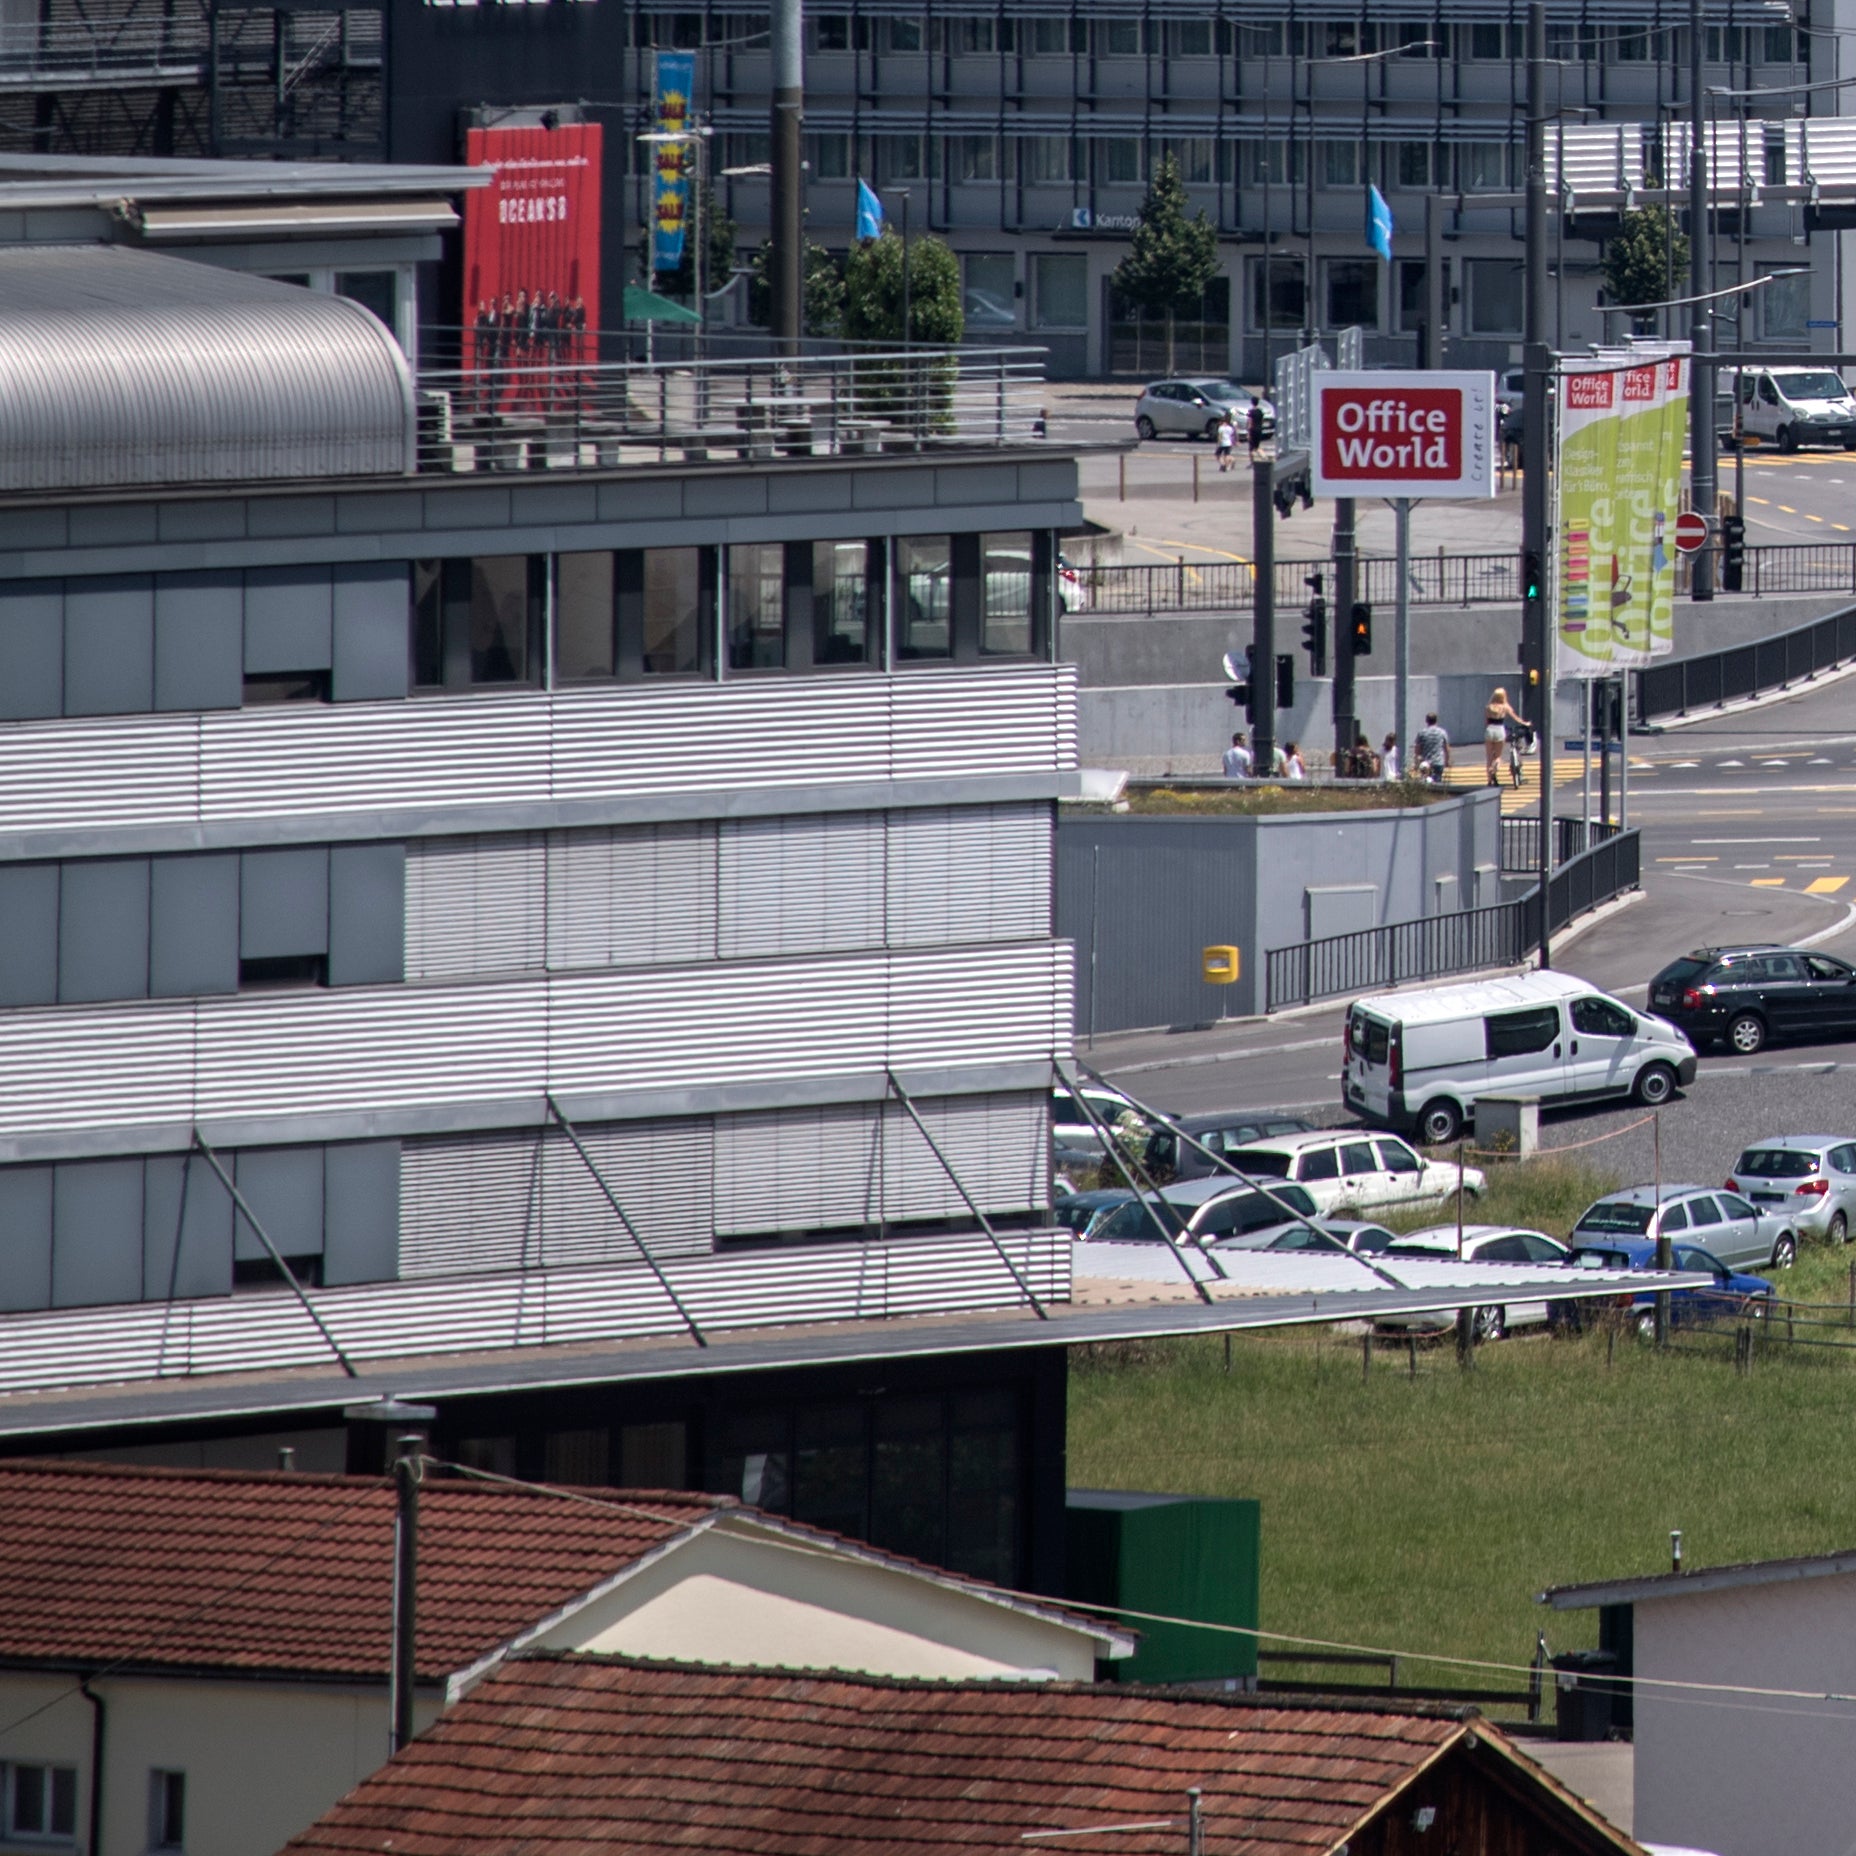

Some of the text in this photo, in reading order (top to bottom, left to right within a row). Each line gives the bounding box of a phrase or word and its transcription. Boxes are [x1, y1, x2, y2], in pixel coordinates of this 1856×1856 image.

[1627, 370, 1651, 383] fice
[1571, 377, 1610, 392] Office
[1624, 384, 1650, 397] orld
[1570, 391, 1608, 405] World
[1336, 400, 1447, 433] Office
[1336, 436, 1449, 469] World
[1471, 423, 1484, 482] Create
